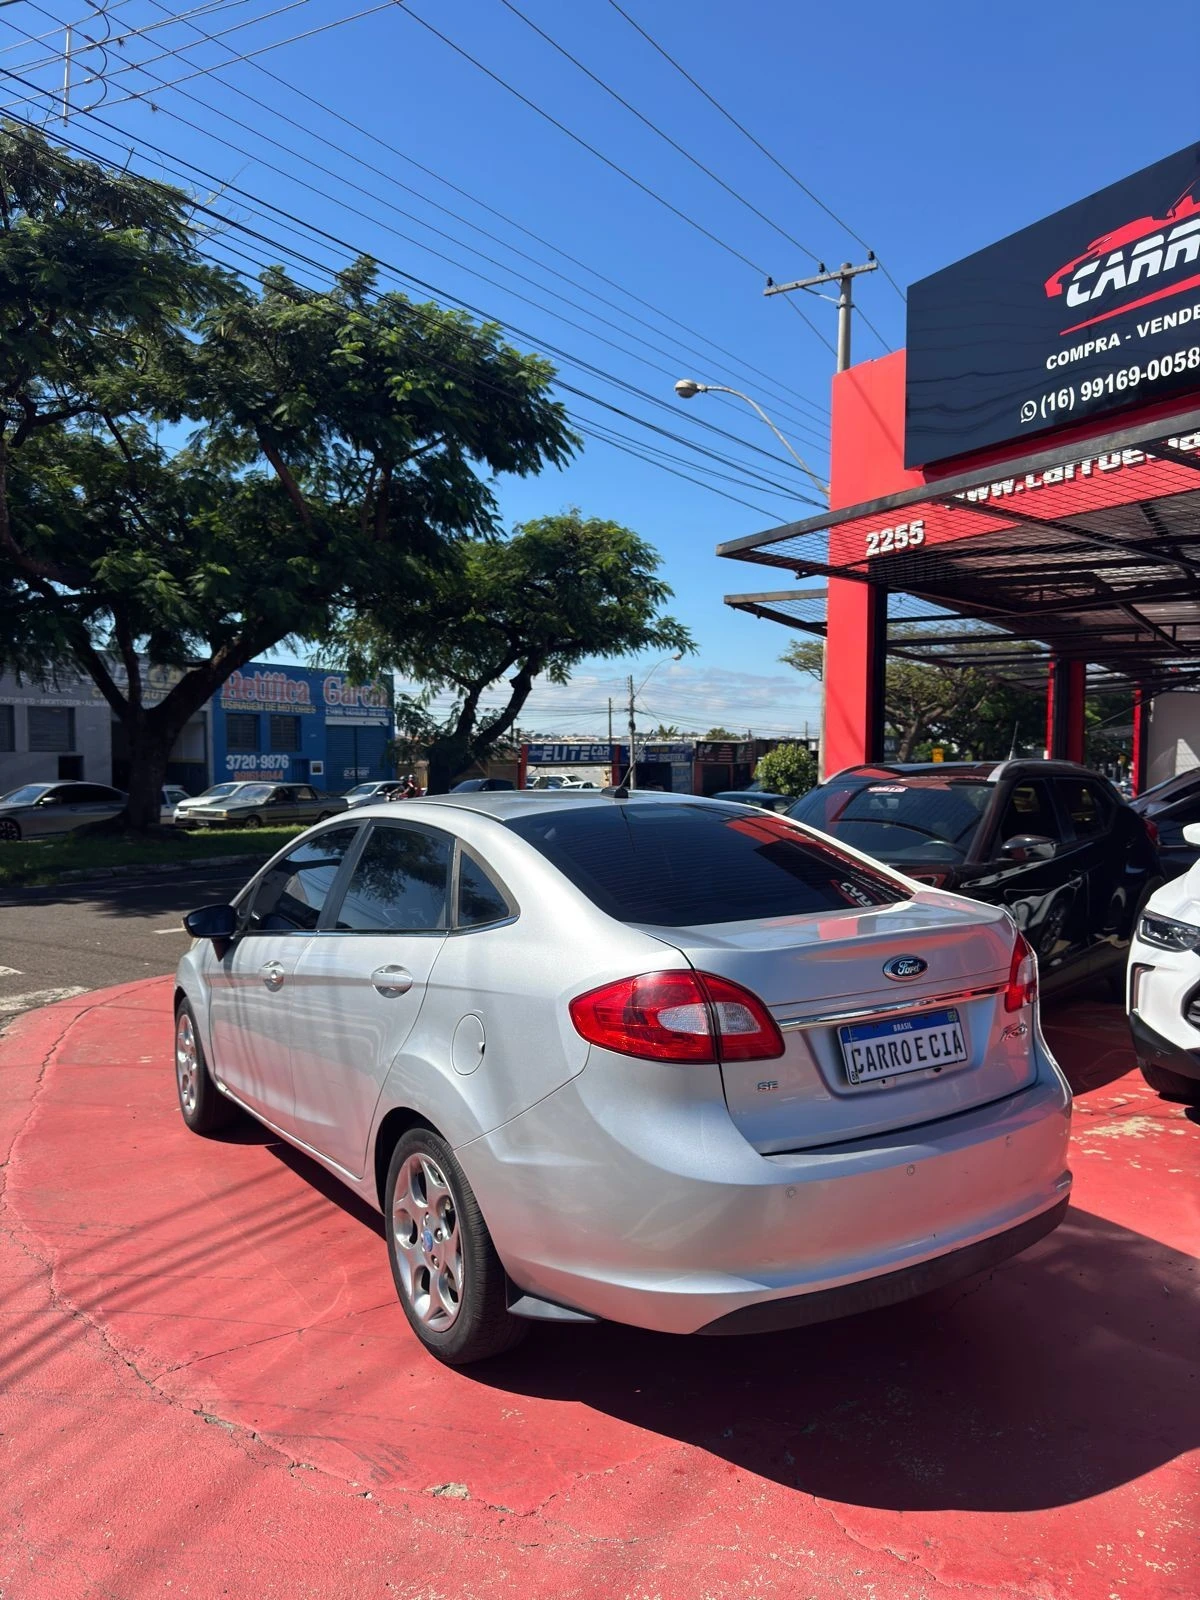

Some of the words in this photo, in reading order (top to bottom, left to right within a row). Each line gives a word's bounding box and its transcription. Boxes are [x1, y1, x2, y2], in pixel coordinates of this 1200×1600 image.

[1046, 332, 1121, 370] COMPRA
[1040, 386, 1075, 419] (16)
[1080, 346, 1200, 401] 99169-0058
[865, 520, 924, 557] 2255
[542, 745, 591, 761] ELITE
[591, 746, 610, 756] CAR
[898, 960, 920, 975] Ford
[893, 1022, 912, 1032] BRASIL
